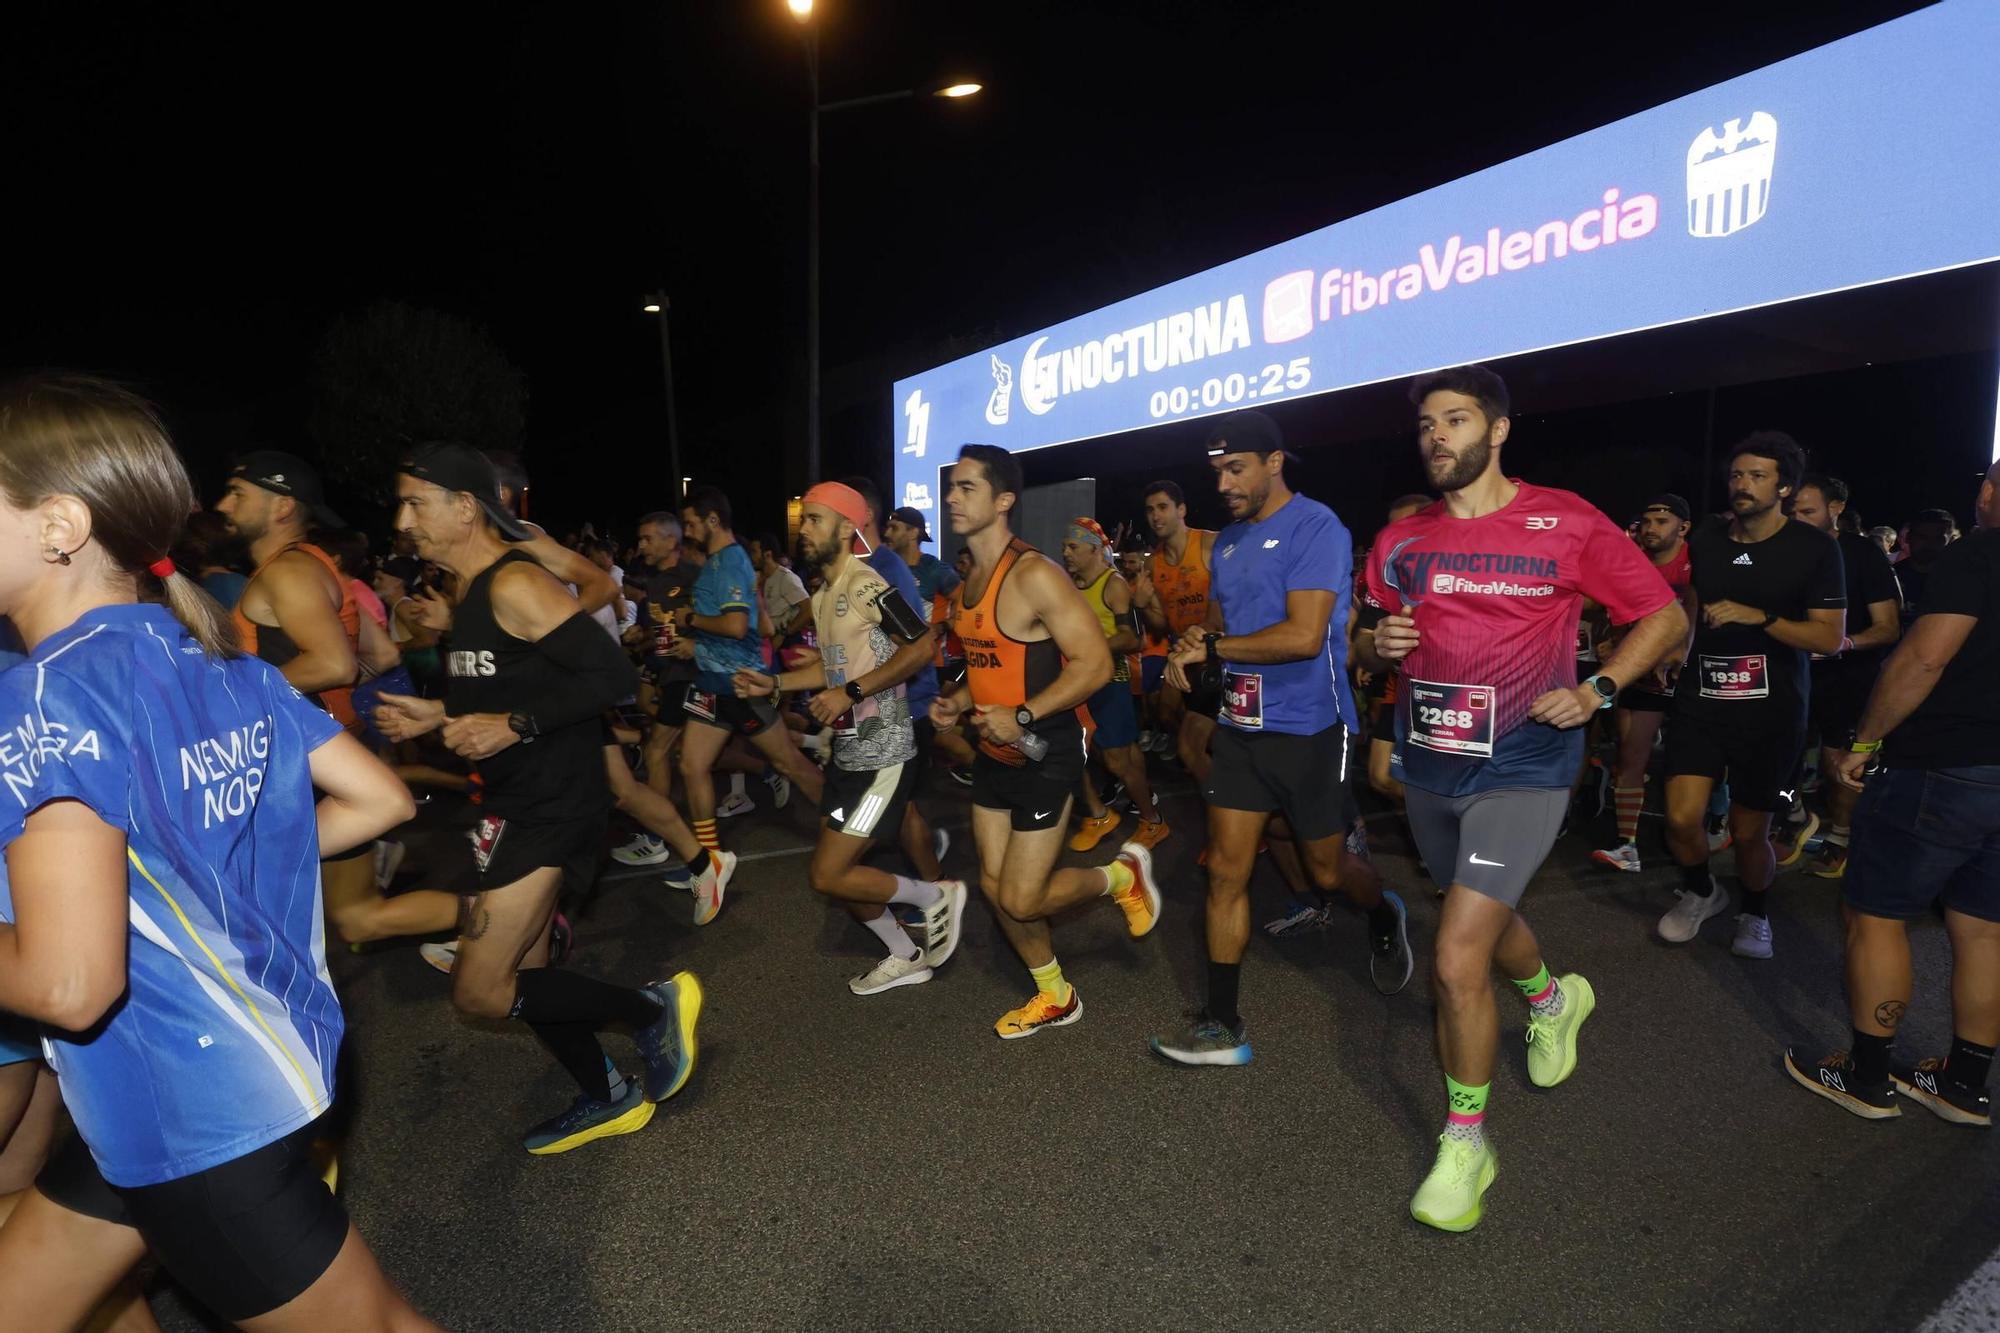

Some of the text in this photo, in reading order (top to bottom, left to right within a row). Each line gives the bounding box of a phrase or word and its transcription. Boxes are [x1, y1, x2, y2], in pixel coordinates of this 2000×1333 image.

[1062, 294, 1251, 395] NOCTURNA
[1150, 356, 1312, 418] 00:00:25
[1437, 552, 1560, 579] NOCTURNA
[1710, 671, 1752, 684] 1938
[1420, 706, 1473, 729] 2268
